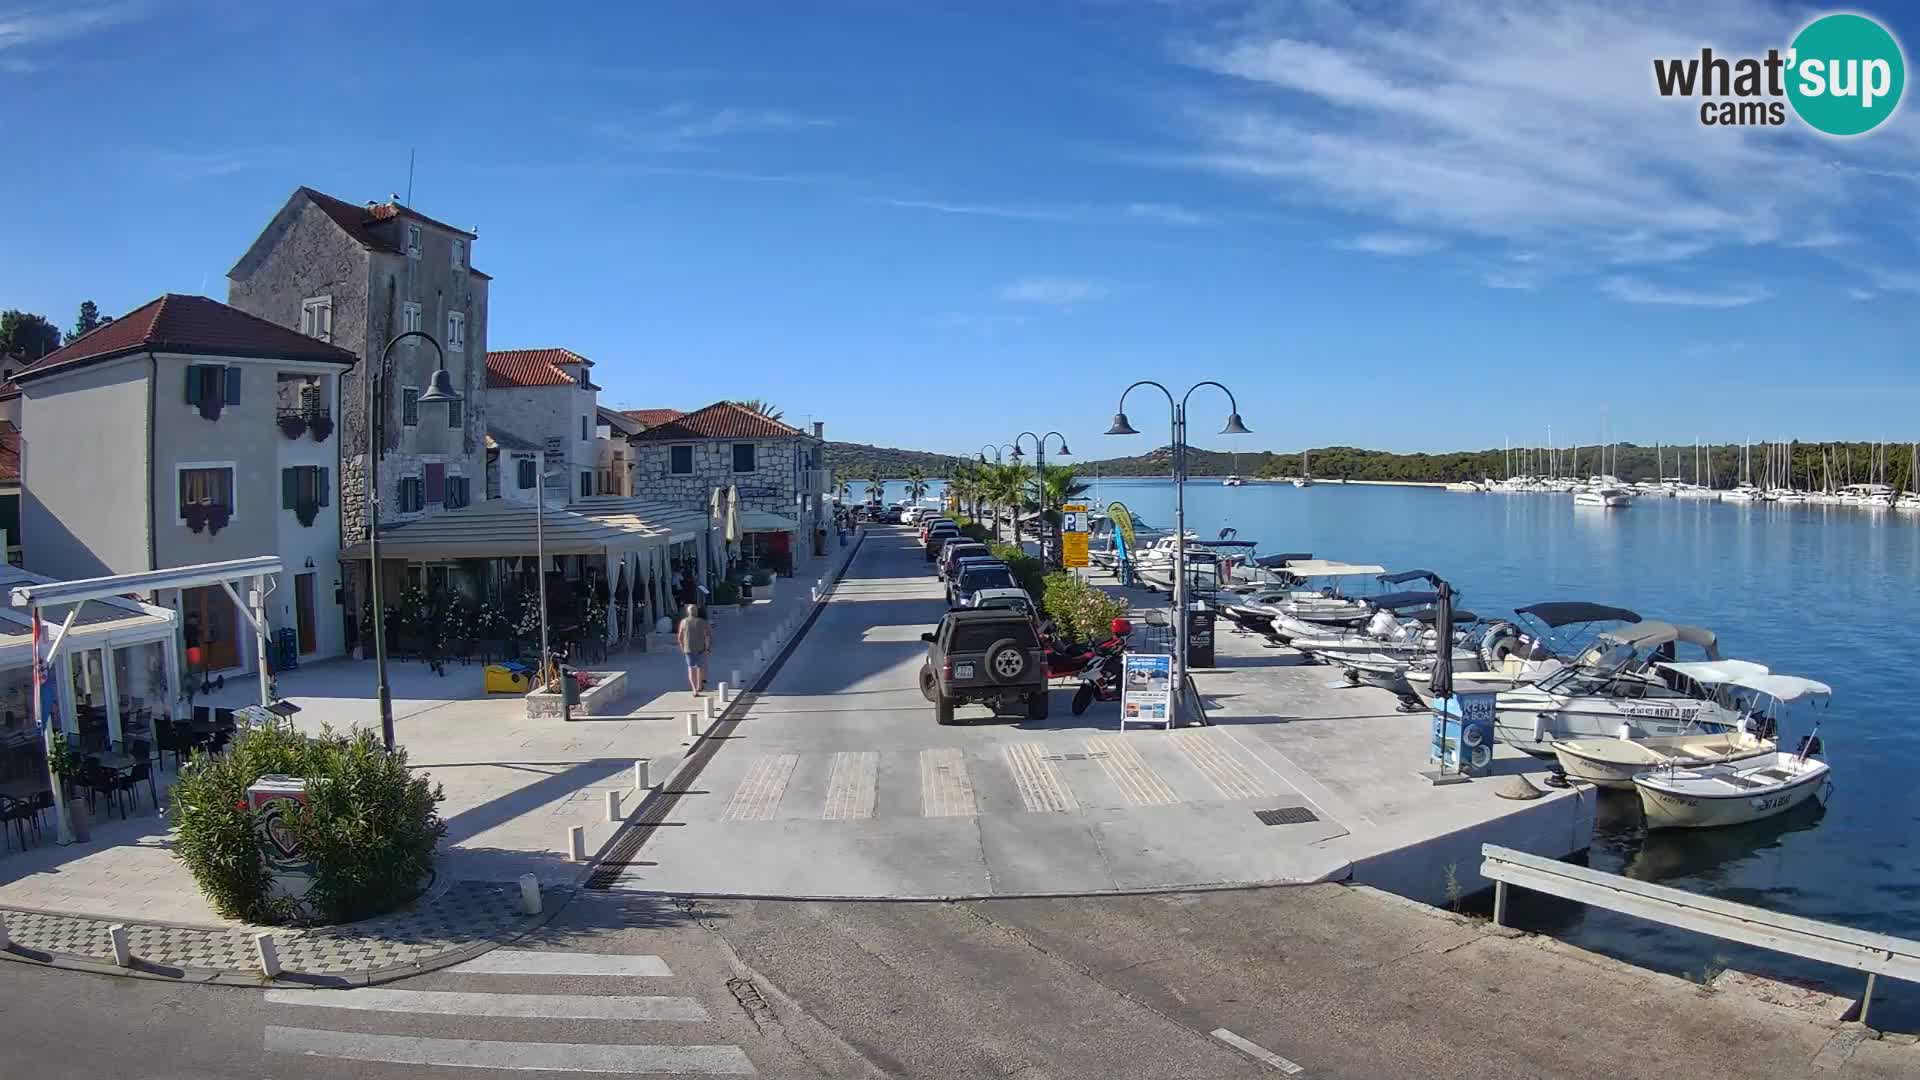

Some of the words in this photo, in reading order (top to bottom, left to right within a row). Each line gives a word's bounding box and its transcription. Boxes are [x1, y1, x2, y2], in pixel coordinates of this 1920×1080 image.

[1064, 514, 1075, 530] P
[1463, 700, 1494, 712] RENT
[1463, 711, 1471, 721] A
[1471, 710, 1494, 721] BOAT
[1654, 707, 1674, 717] RENT
